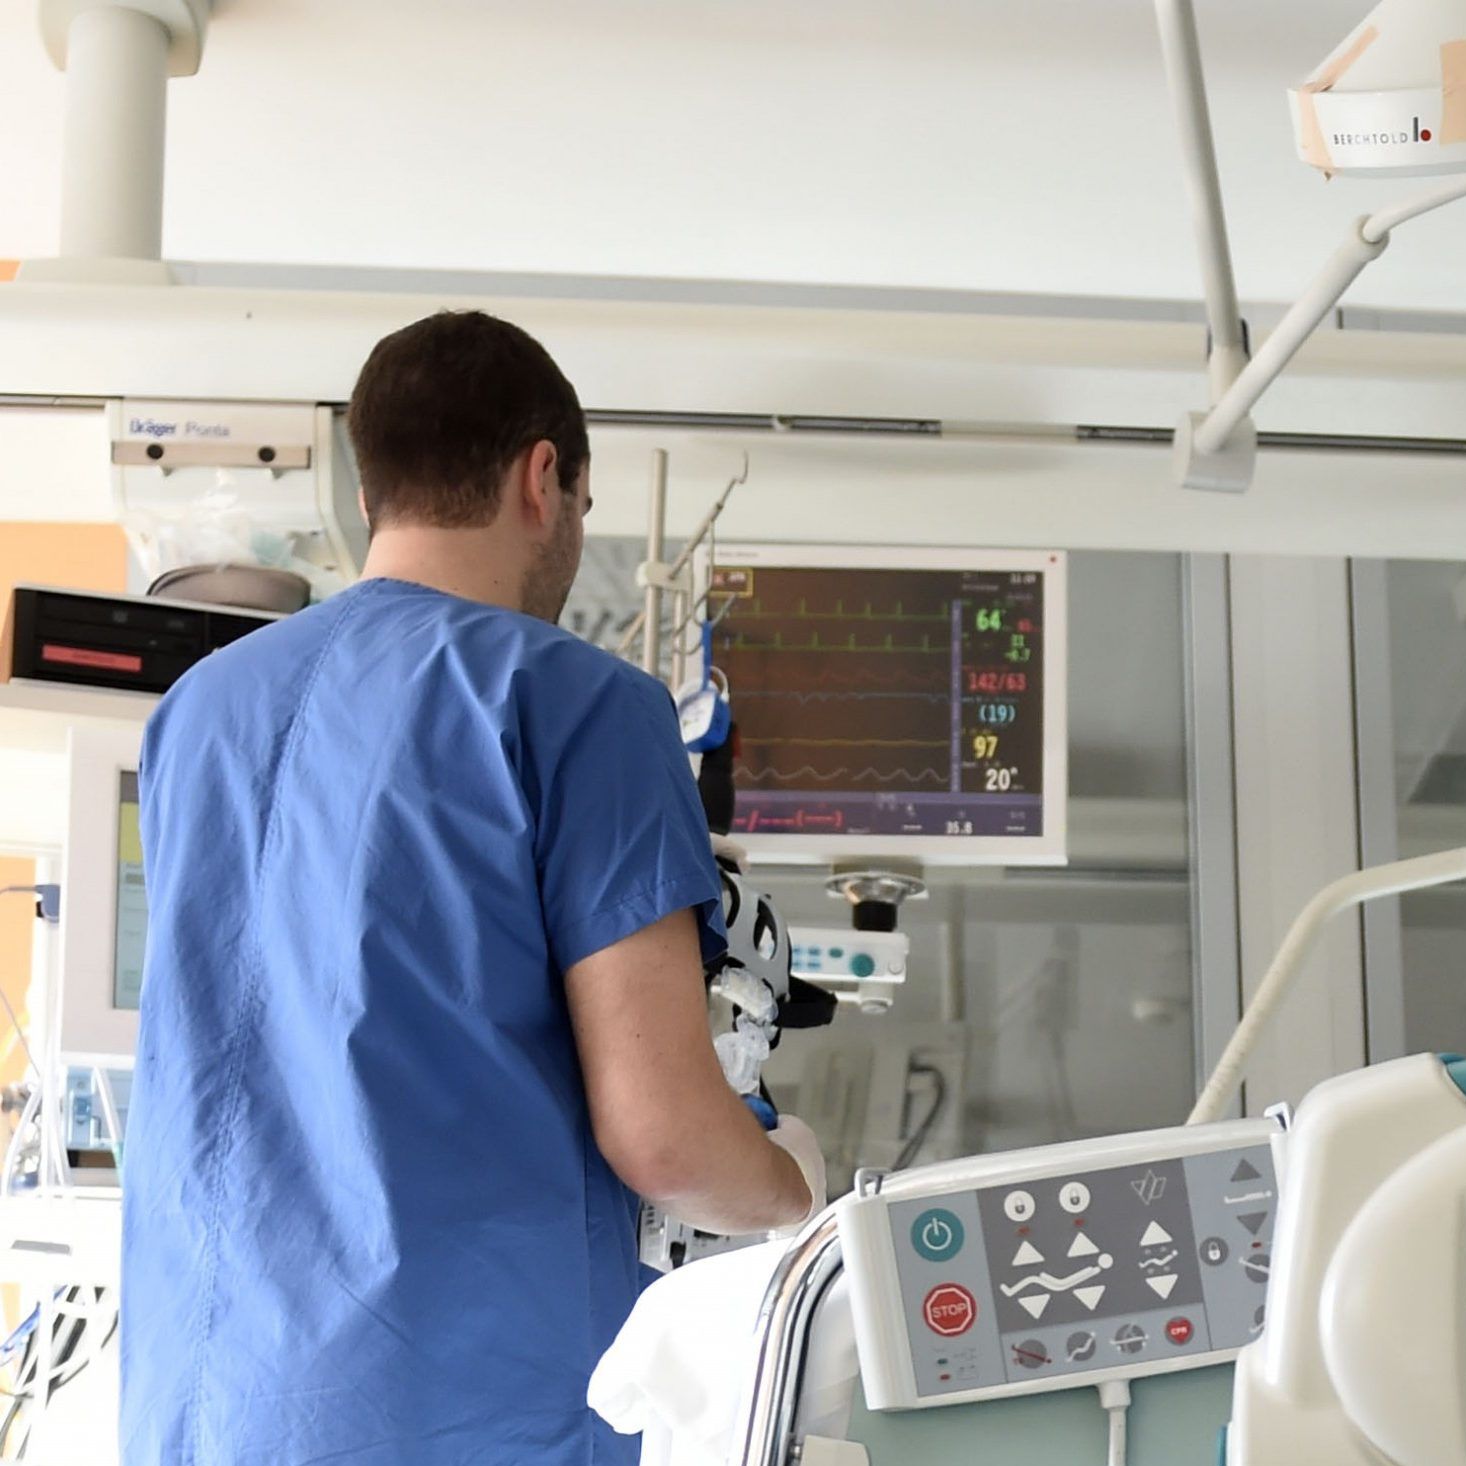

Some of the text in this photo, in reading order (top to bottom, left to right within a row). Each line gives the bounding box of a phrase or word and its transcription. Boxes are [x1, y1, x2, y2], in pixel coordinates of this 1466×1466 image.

[1333, 132, 1408, 145] BERCHTOLD
[977, 608, 1002, 632] 64
[979, 704, 1016, 723] (19)
[973, 735, 998, 759] 97
[932, 1303, 966, 1318] STOP
